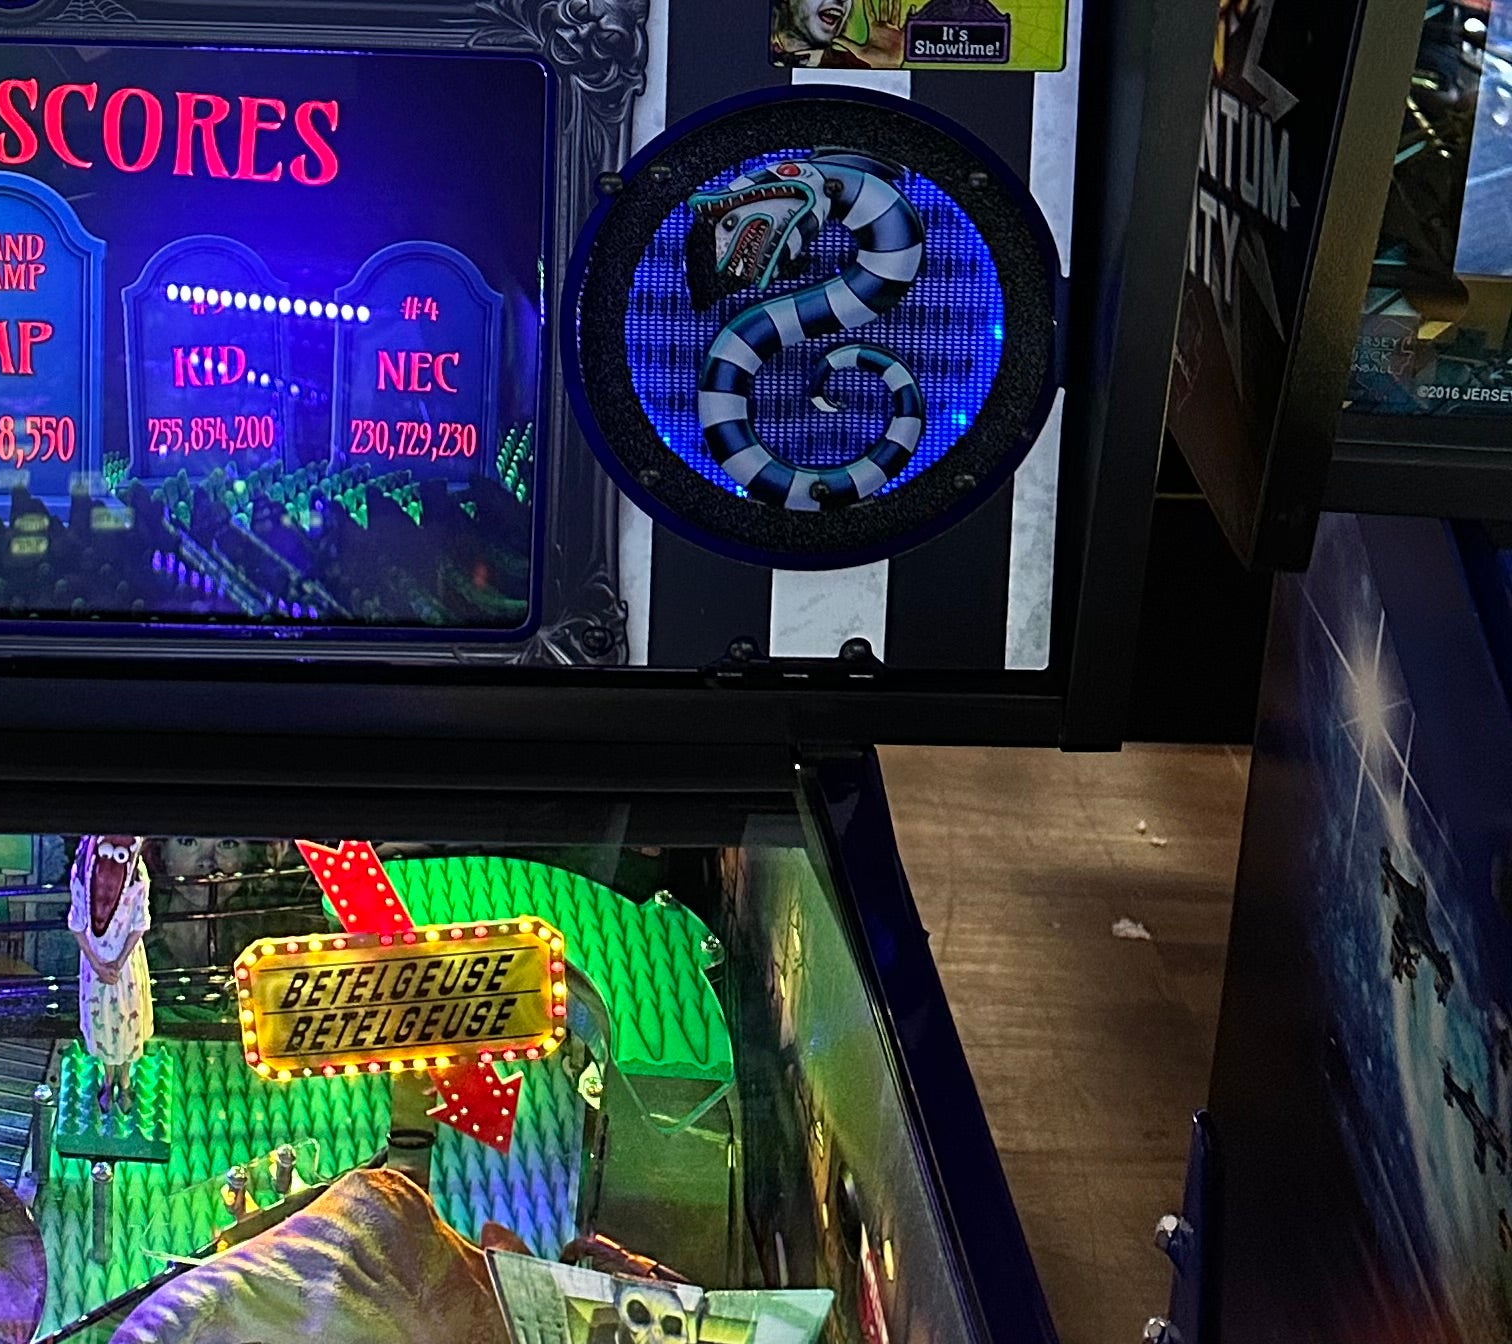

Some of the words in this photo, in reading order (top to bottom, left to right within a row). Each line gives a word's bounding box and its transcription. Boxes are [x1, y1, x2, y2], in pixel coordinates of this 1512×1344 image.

[914, 39, 1001, 56] Showtime!
[942, 26, 968, 42] It's
[400, 296, 439, 321] #4
[172, 345, 246, 388] KID
[377, 350, 460, 393] NEC
[1417, 385, 1460, 400] ©2016
[1462, 387, 1512, 402] JERSE
[148, 415, 275, 456] 255,854,200
[350, 420, 477, 462] 230,729,230
[280, 953, 516, 1010] BETELGEUSE
[283, 998, 518, 1053] BETELGEUSE
